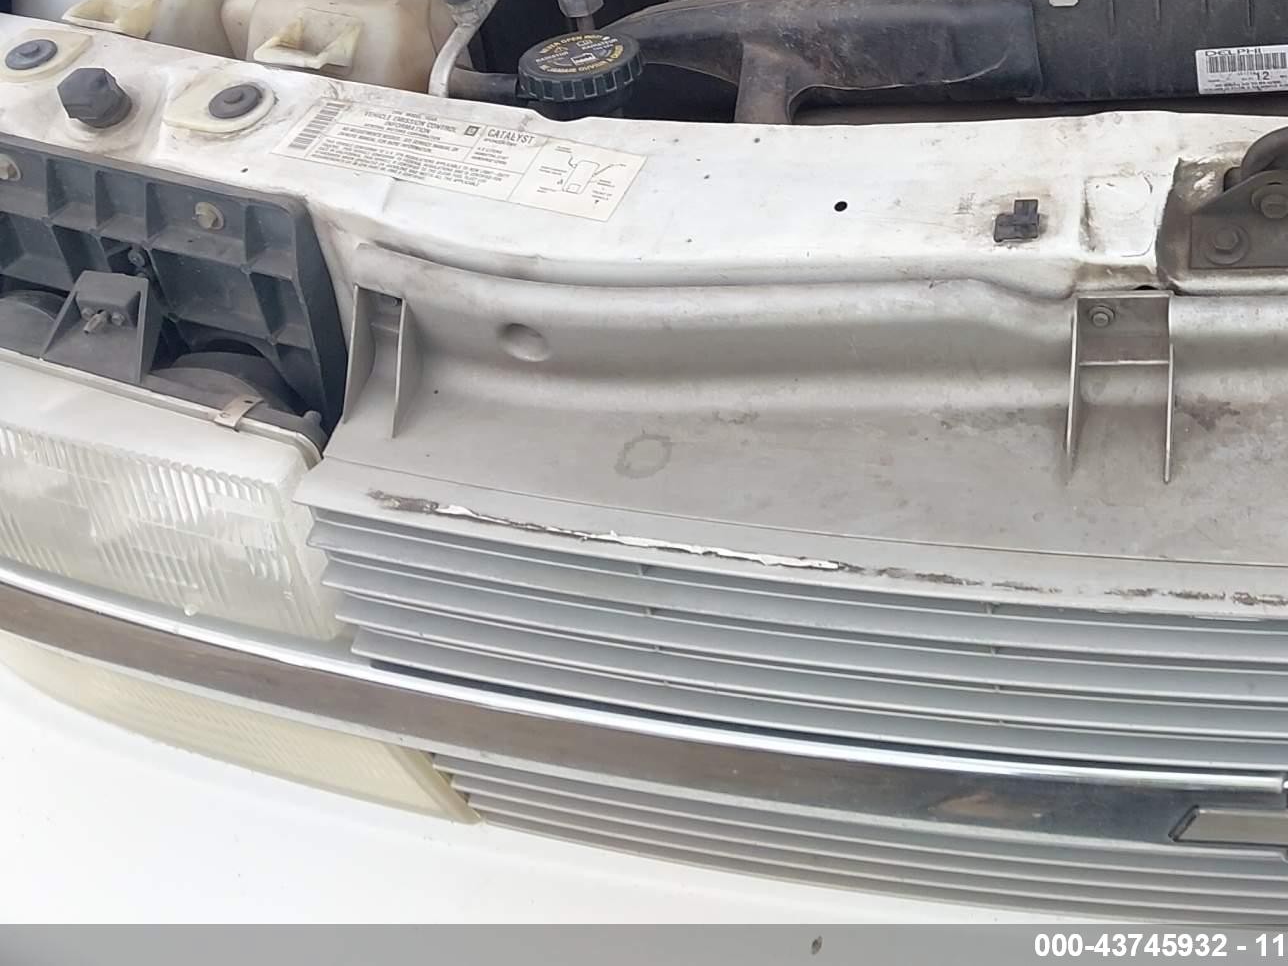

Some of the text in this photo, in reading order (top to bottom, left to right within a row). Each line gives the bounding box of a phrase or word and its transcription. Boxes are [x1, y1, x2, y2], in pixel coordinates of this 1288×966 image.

[1205, 48, 1262, 57] DELPHI
[1255, 71, 1271, 81] 12
[427, 121, 457, 133] CONTROL
[487, 128, 536, 145] CATALYST
